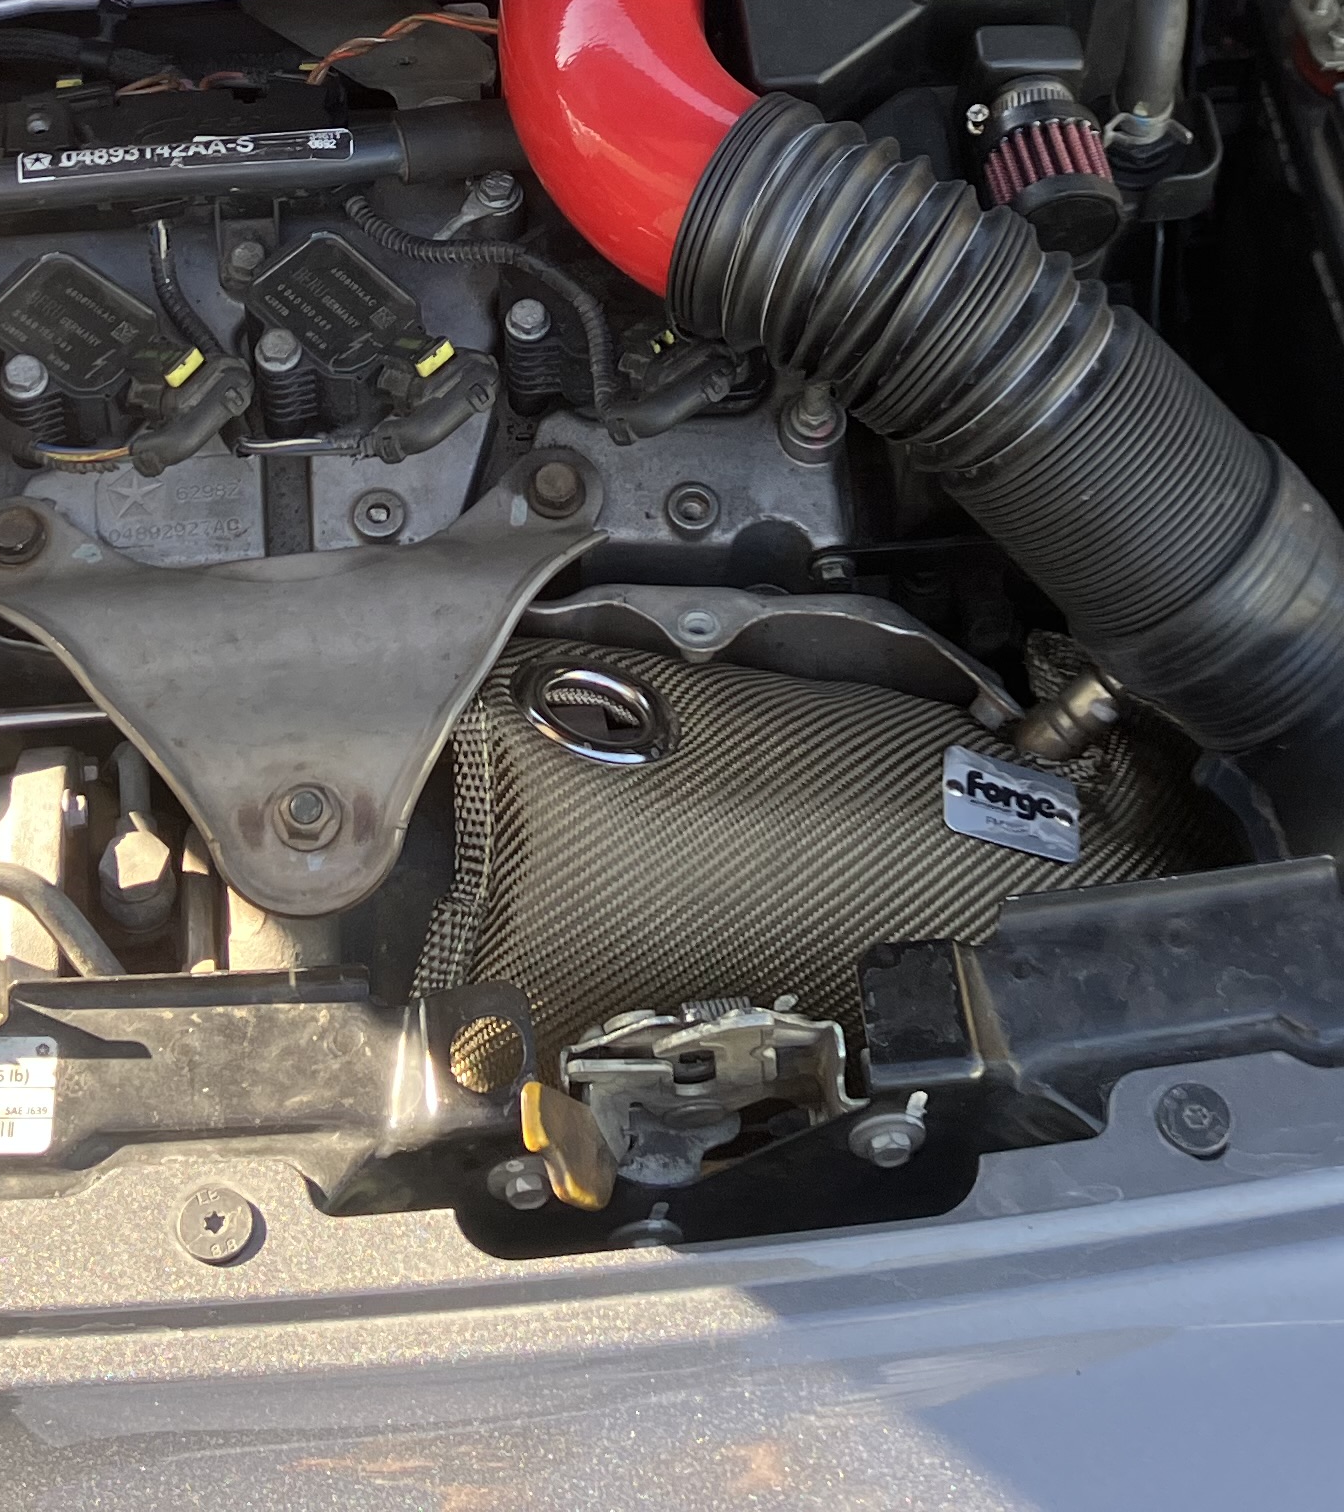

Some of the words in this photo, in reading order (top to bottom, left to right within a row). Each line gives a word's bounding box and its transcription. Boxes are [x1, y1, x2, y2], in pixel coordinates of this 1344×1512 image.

[321, 294, 362, 329] GERMANY
[59, 317, 102, 347] GERMANY
[9, 1069, 30, 1085] lb)
[5, 1106, 23, 1116] SAE
[26, 1106, 48, 1115] J639
